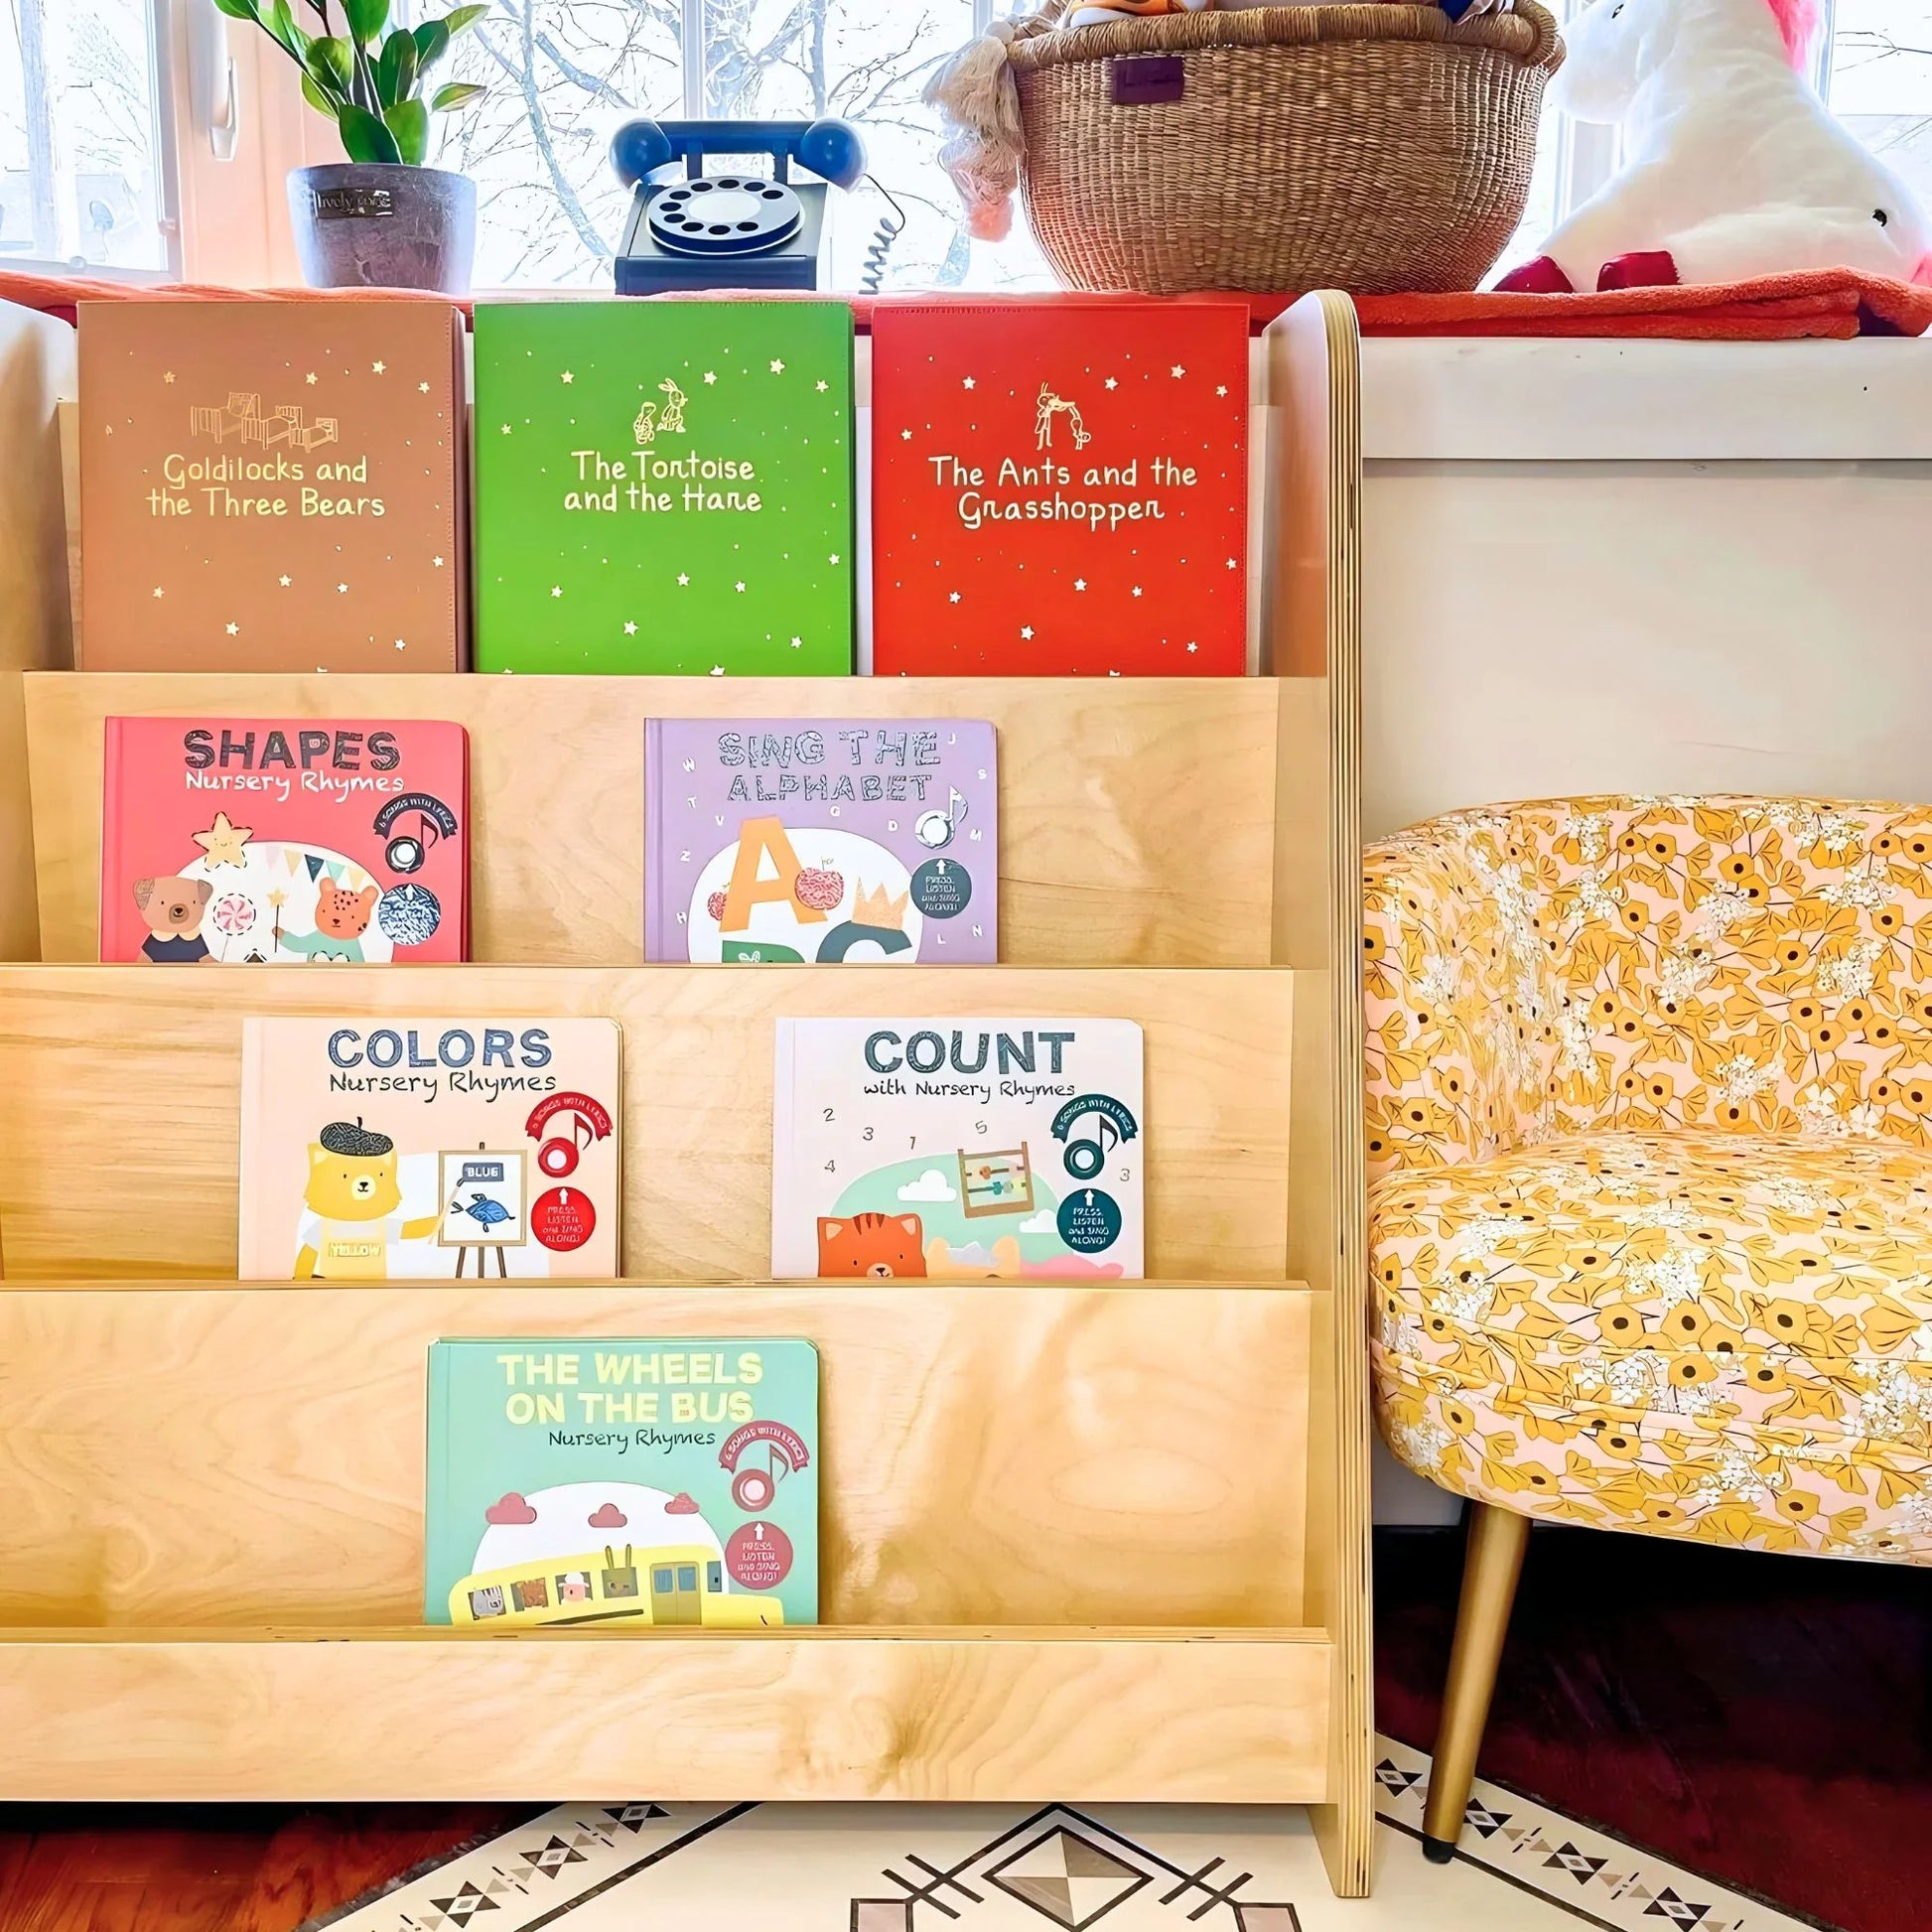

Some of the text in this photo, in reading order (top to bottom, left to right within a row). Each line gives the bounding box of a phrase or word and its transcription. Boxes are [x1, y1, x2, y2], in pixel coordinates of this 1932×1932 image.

[164, 452, 367, 489] Goldilocks and
[570, 449, 756, 481] The Tortoise
[927, 455, 1198, 487] The Ants and the
[145, 486, 386, 517] the Three Bears
[564, 482, 762, 512] and the Hare
[958, 490, 1166, 532] Grasshopper
[184, 729, 401, 770] SHAPES
[718, 730, 941, 768] SING THE
[947, 733, 956, 745] J
[185, 770, 405, 803] Nursery Rhymes
[727, 773, 932, 801] ALPHABET
[977, 768, 987, 780] S
[687, 796, 697, 809] T
[715, 815, 725, 826] V
[888, 819, 898, 832] D
[718, 815, 829, 932] A
[937, 933, 947, 944] L
[973, 924, 983, 937] N
[328, 1028, 552, 1069] COLORS
[864, 1031, 1075, 1074] COUNT
[329, 1069, 556, 1103] Nursery Rhymes
[864, 1079, 1076, 1105] with Nursery Rhymes
[823, 1108, 835, 1122] 2
[975, 1120, 988, 1135] 5
[862, 1127, 875, 1142] 3
[468, 1167, 498, 1177] BLUE
[824, 1159, 836, 1173] 4
[329, 1243, 381, 1257] YELLOW
[496, 1351, 763, 1386] THE WHEELS
[505, 1391, 755, 1425] ON THE BUS
[548, 1429, 716, 1454] Nursery Rhymes
